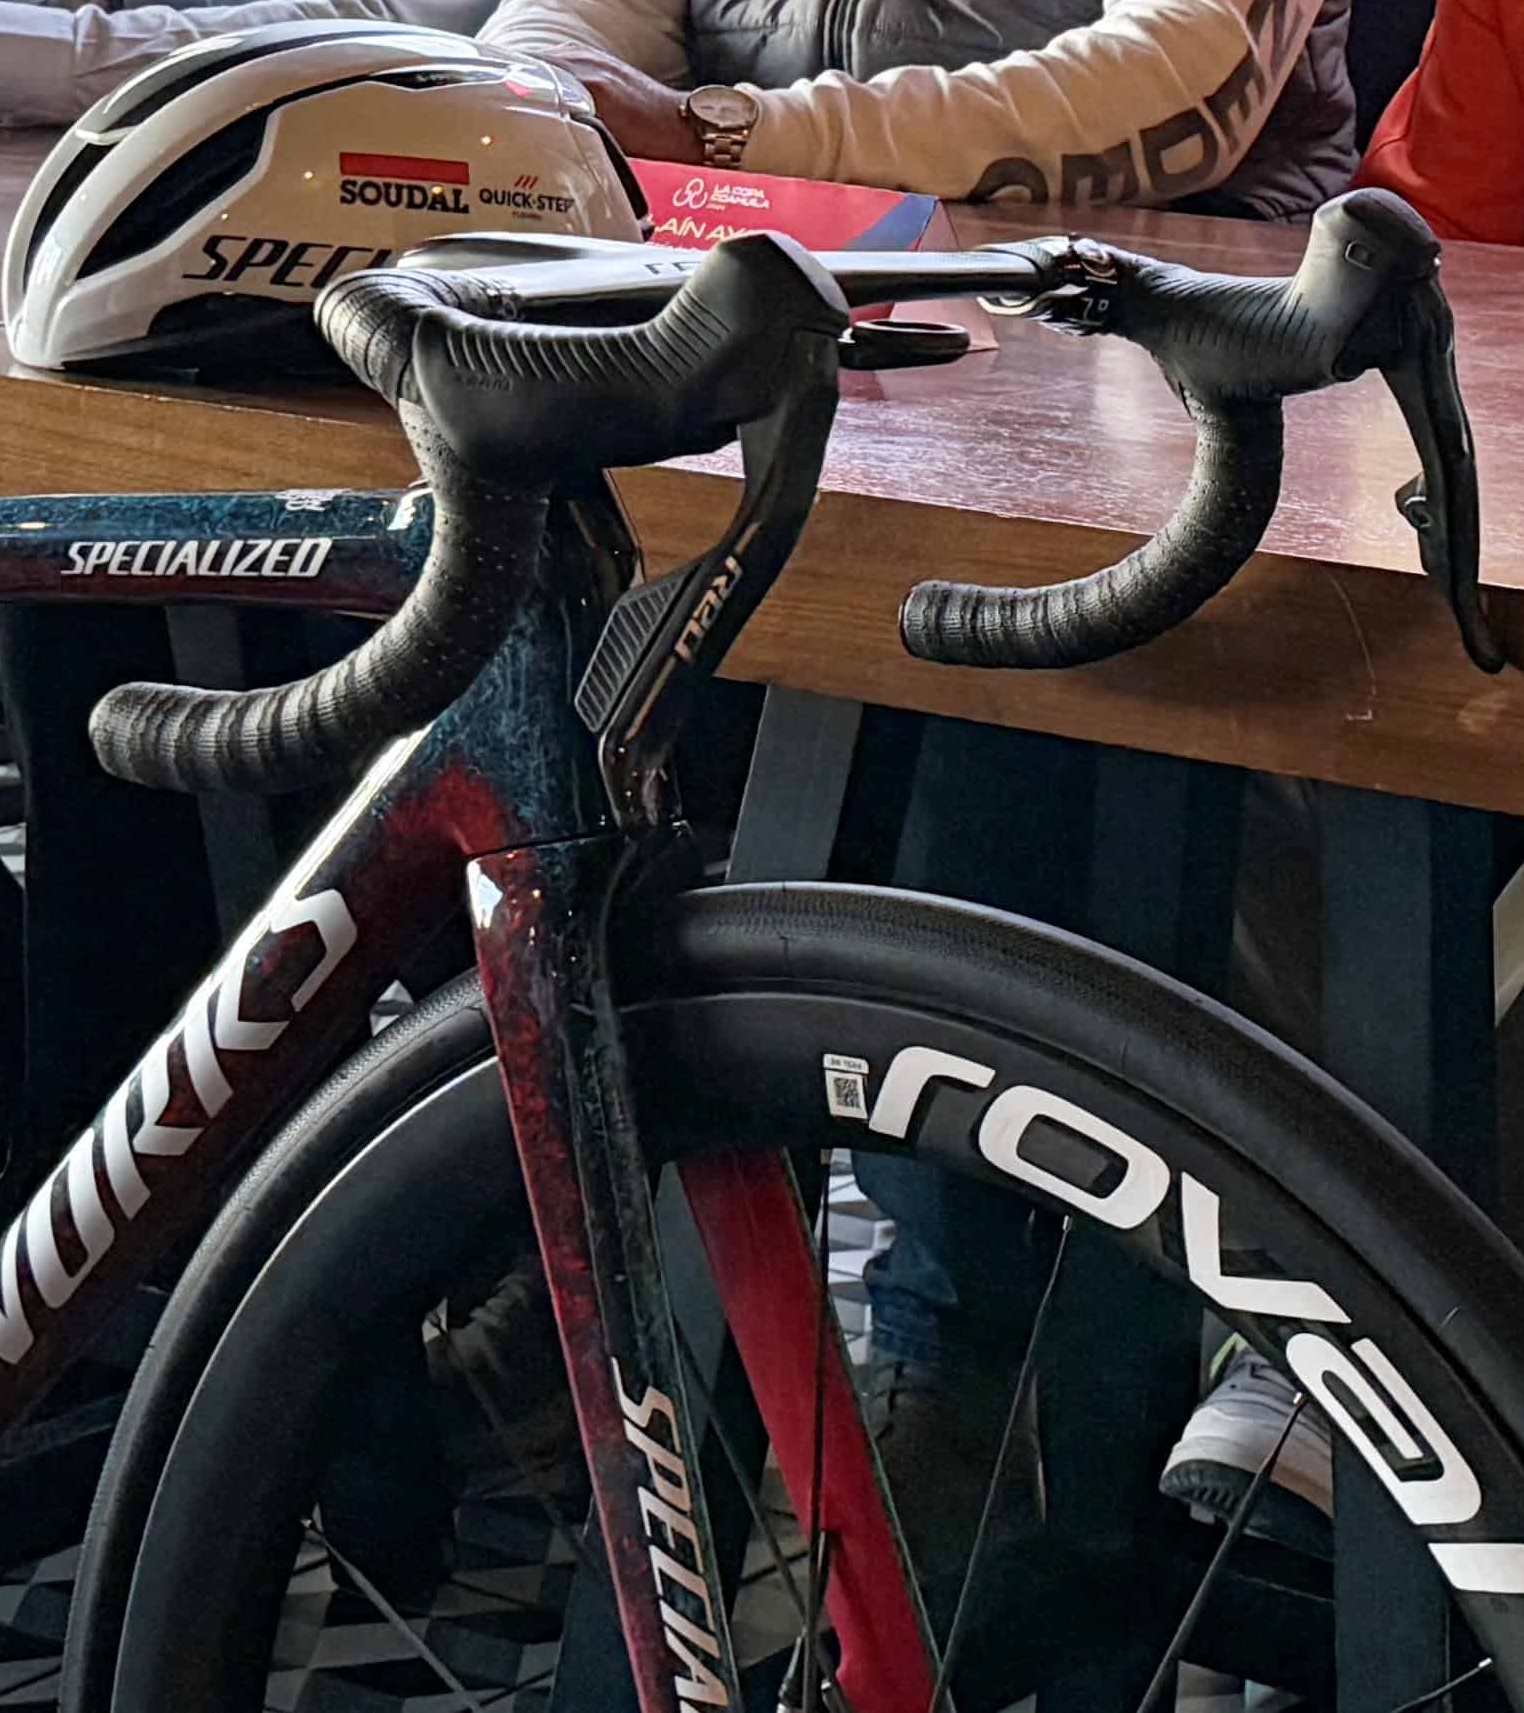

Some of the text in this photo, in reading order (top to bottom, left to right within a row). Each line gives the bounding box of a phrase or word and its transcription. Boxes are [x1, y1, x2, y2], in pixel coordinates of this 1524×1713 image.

[340, 179, 470, 215] SOUDAL
[61, 538, 333, 578] SPECIALIZED
[612, 1356, 729, 1713] SPECIA
